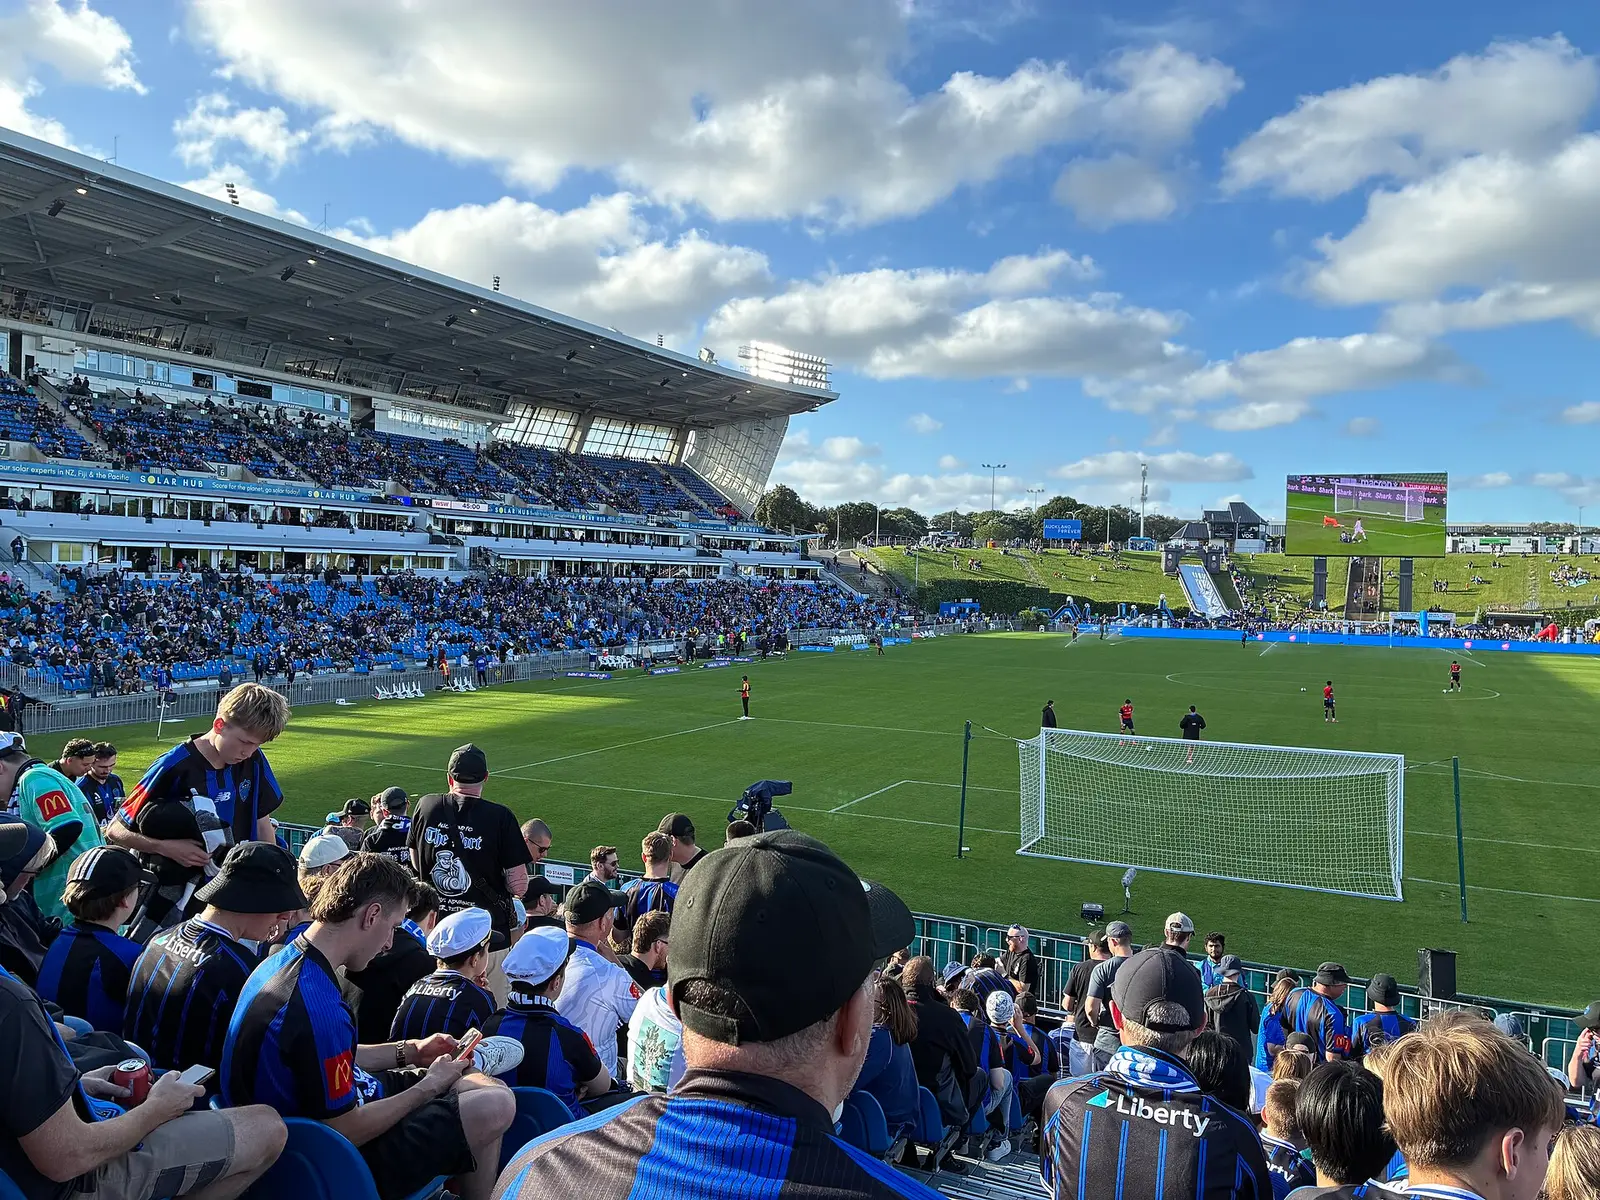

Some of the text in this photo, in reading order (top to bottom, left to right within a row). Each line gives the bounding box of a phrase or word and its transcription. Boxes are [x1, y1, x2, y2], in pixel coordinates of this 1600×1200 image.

[12, 464, 29, 472] solar
[31, 466, 56, 476] experts
[78, 470, 88, 479] Fiji
[96, 471, 107, 479] the
[108, 473, 130, 481] Pacific
[219, 469, 225, 477] 6
[140, 475, 204, 488] SOLAR HUB
[307, 490, 356, 501] SOLAR HUB
[1336, 488, 1353, 496] Shark
[1375, 492, 1392, 500] Shark
[1418, 495, 1438, 504] Shark
[461, 502, 481, 510] 45:00
[494, 506, 515, 514] SOLAR
[165, 935, 212, 967] Liberty
[415, 984, 462, 1001] Liberty
[1116, 1094, 1211, 1138] Liberty
